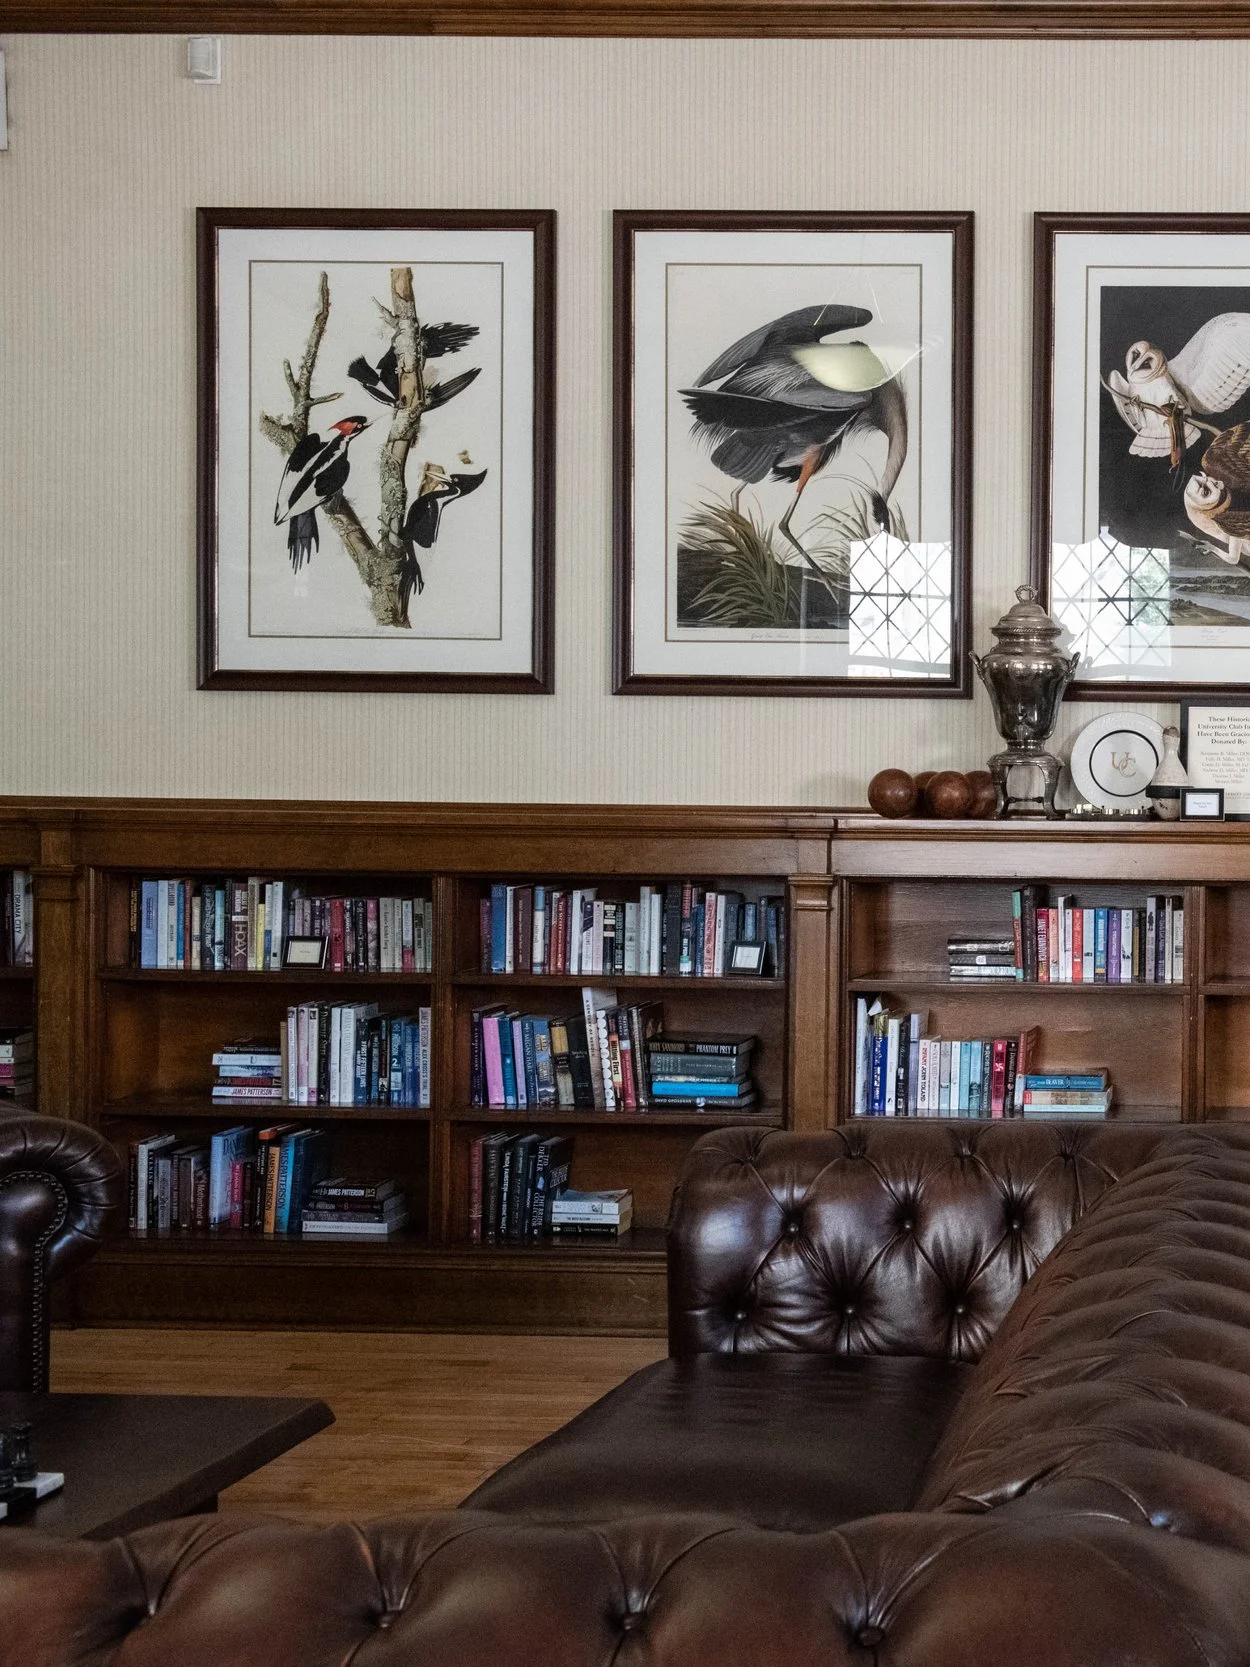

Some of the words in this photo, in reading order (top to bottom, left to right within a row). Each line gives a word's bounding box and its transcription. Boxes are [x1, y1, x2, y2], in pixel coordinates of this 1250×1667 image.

[1037, 919, 1046, 934] JANET
[235, 924, 246, 956] HOAX
[1038, 935, 1046, 961] EVANOVICH
[319, 1011, 328, 1037] DANIELLE
[320, 1040, 328, 1055] STEEL
[610, 1040, 618, 1061] Hitting
[696, 1045, 718, 1053] PHANTOM
[720, 1045, 731, 1053] PREY
[612, 1062, 620, 1075] First
[281, 1142, 289, 1165] JAMES
[503, 1153, 511, 1167] LINDA
[537, 1146, 545, 1171] DEKKER
[278, 1166, 288, 1210] PATTERSON
[501, 1168, 509, 1192] FAIRSTEIN
[197, 1184, 205, 1218] Motherhood
[265, 1174, 274, 1211] PATTERSON
[531, 1192, 539, 1227] COLLECTOR
